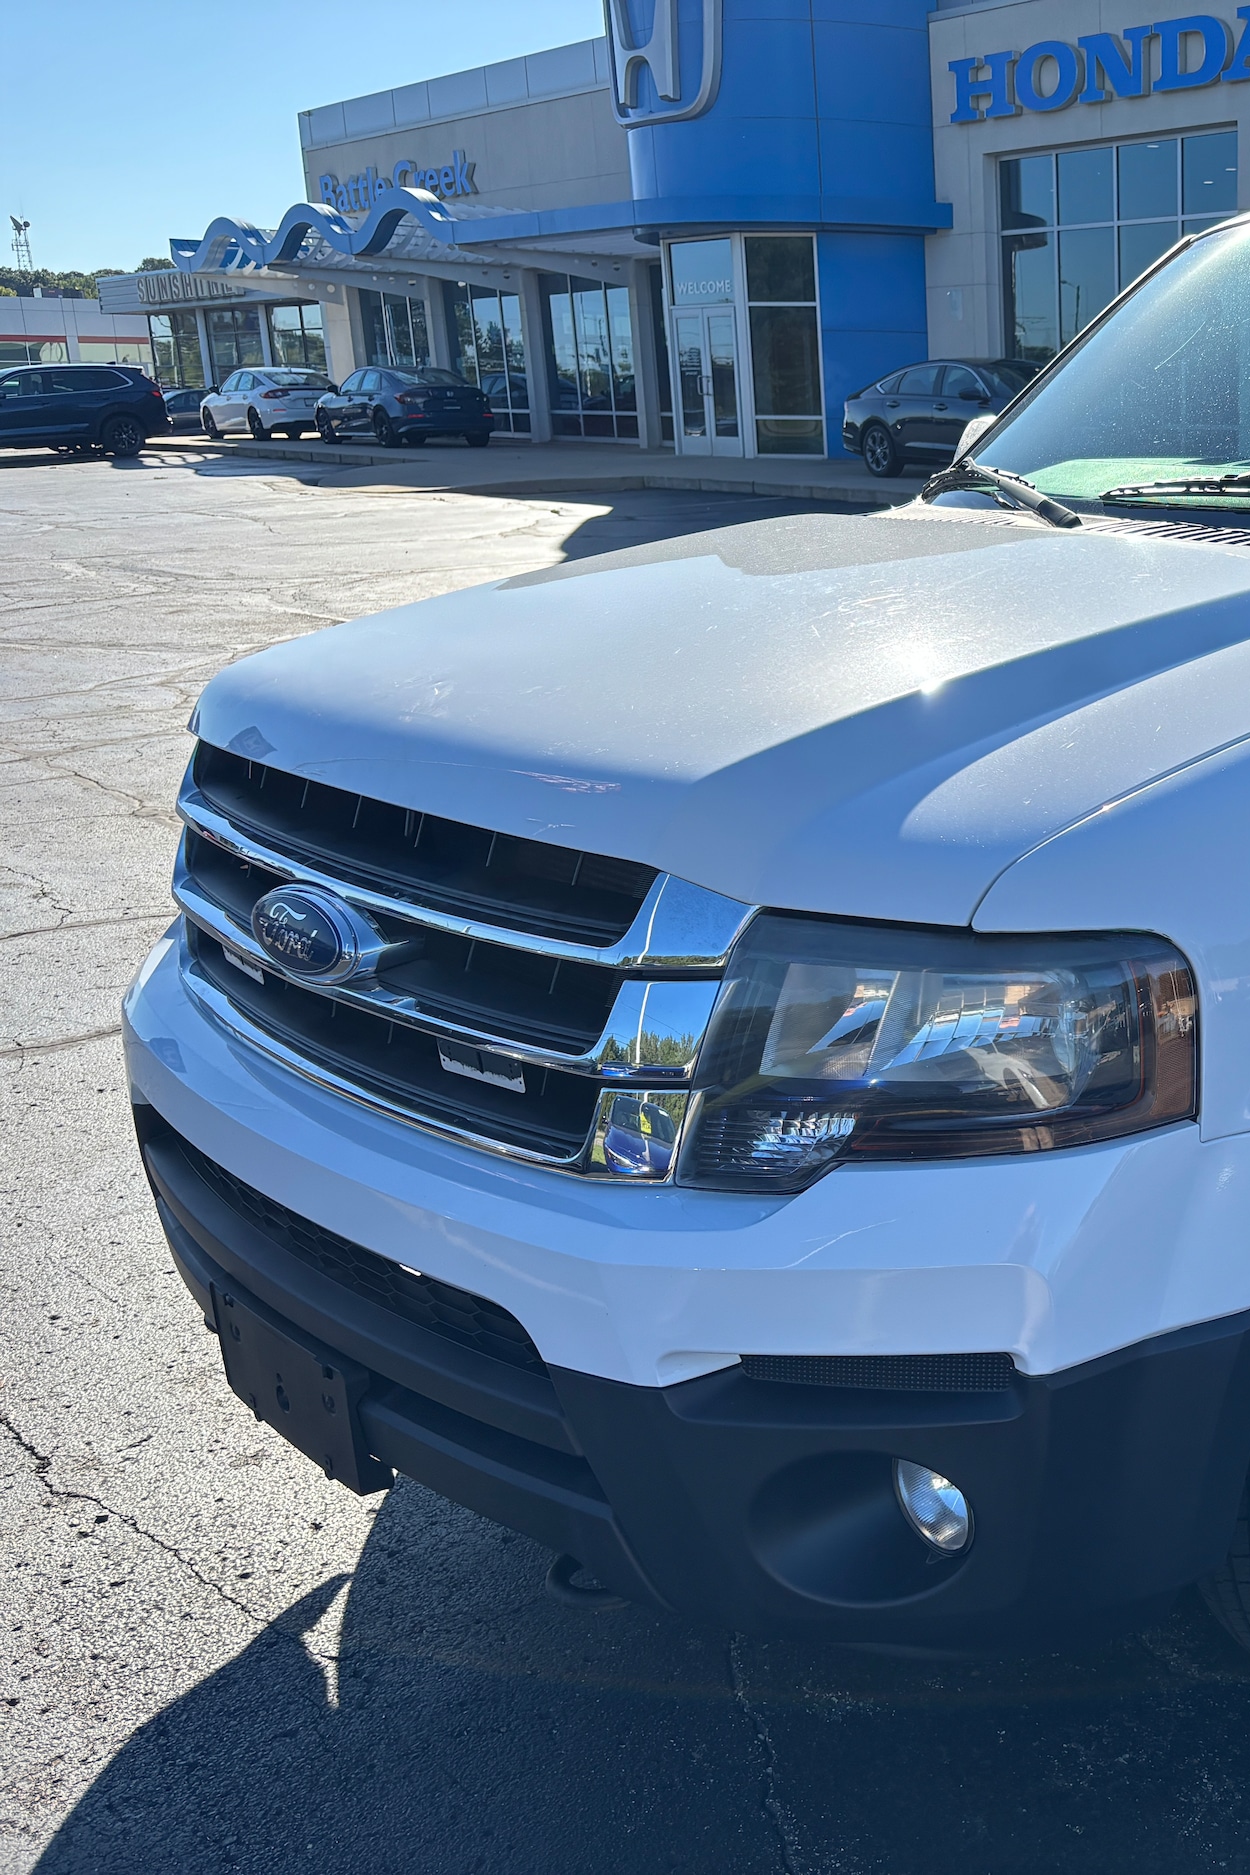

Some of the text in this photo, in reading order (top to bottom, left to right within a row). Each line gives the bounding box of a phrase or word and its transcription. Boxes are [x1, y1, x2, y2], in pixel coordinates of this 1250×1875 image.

[319, 150, 475, 212] Battle Creek
[676, 279, 732, 295] WELCOME
[259, 902, 318, 962] Ford
